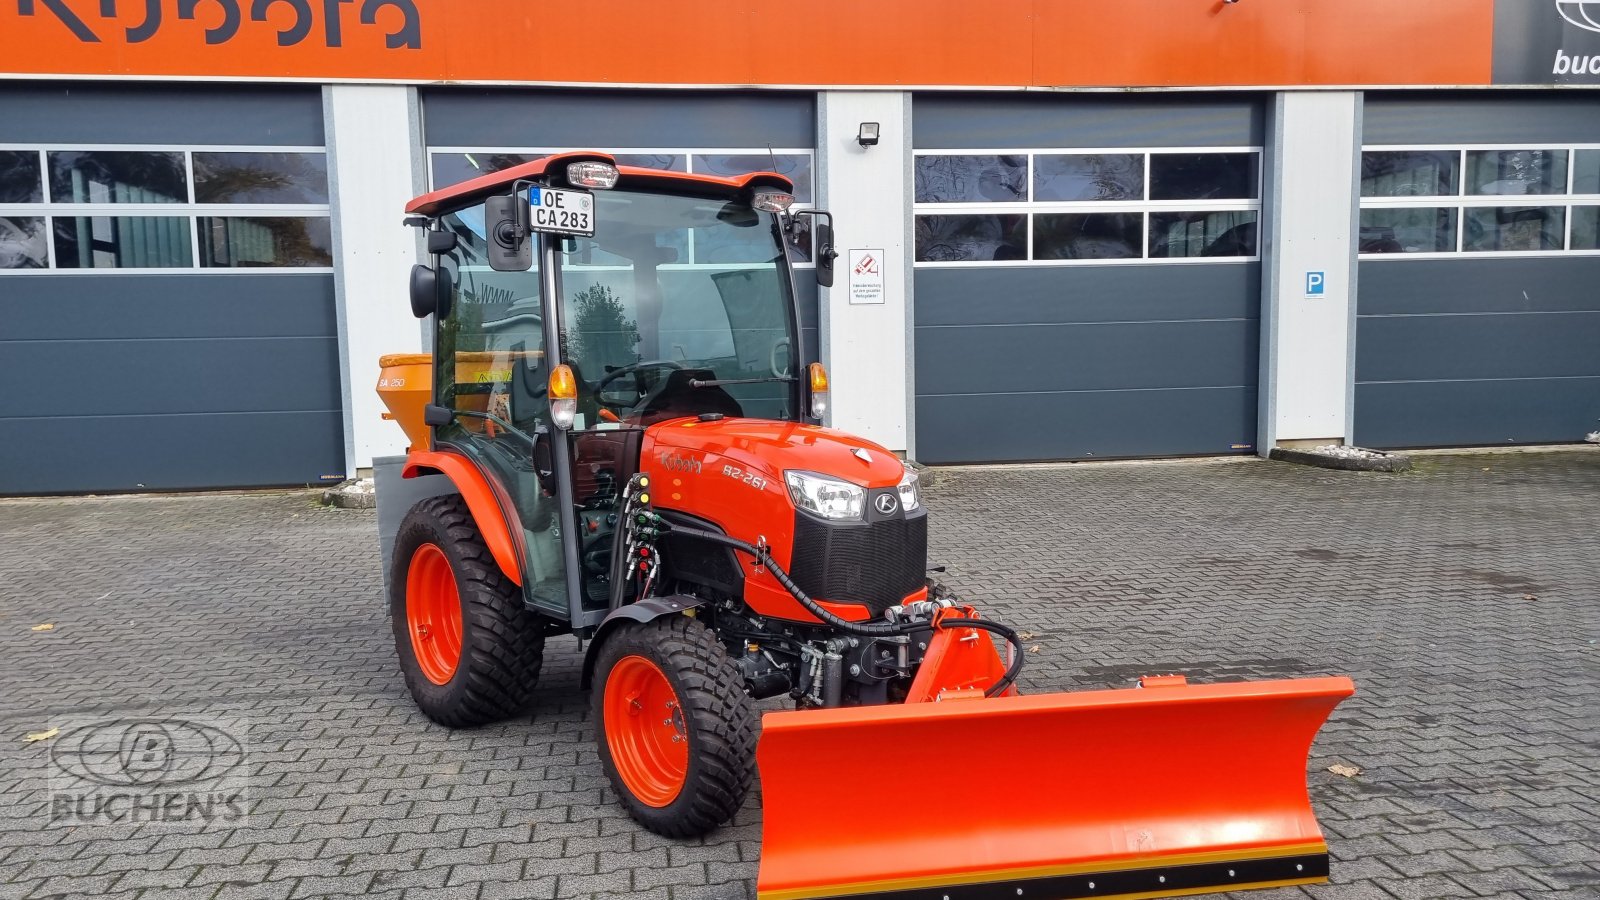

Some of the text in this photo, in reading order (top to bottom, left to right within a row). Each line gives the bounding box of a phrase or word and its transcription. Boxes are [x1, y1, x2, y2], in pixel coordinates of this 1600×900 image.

[544, 191, 565, 209] OE
[536, 208, 588, 229] CA 283
[1309, 273, 1322, 292] P
[391, 378, 405, 387] 250
[661, 450, 702, 474] Kubota
[723, 464, 767, 491] B2-261
